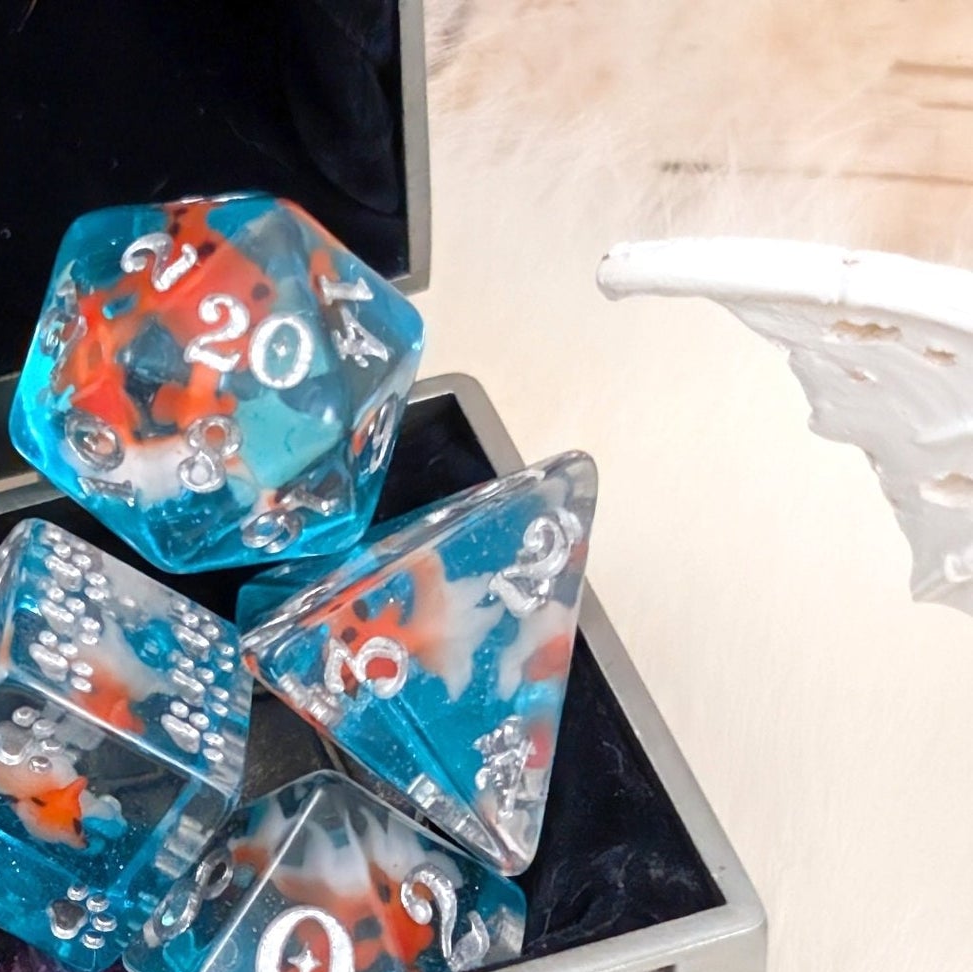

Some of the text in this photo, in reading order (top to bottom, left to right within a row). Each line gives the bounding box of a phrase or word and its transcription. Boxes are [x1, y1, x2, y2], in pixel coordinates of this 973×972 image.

[120, 232, 199, 292] 2
[184, 293, 315, 389] 20
[176, 414, 244, 494] 8
